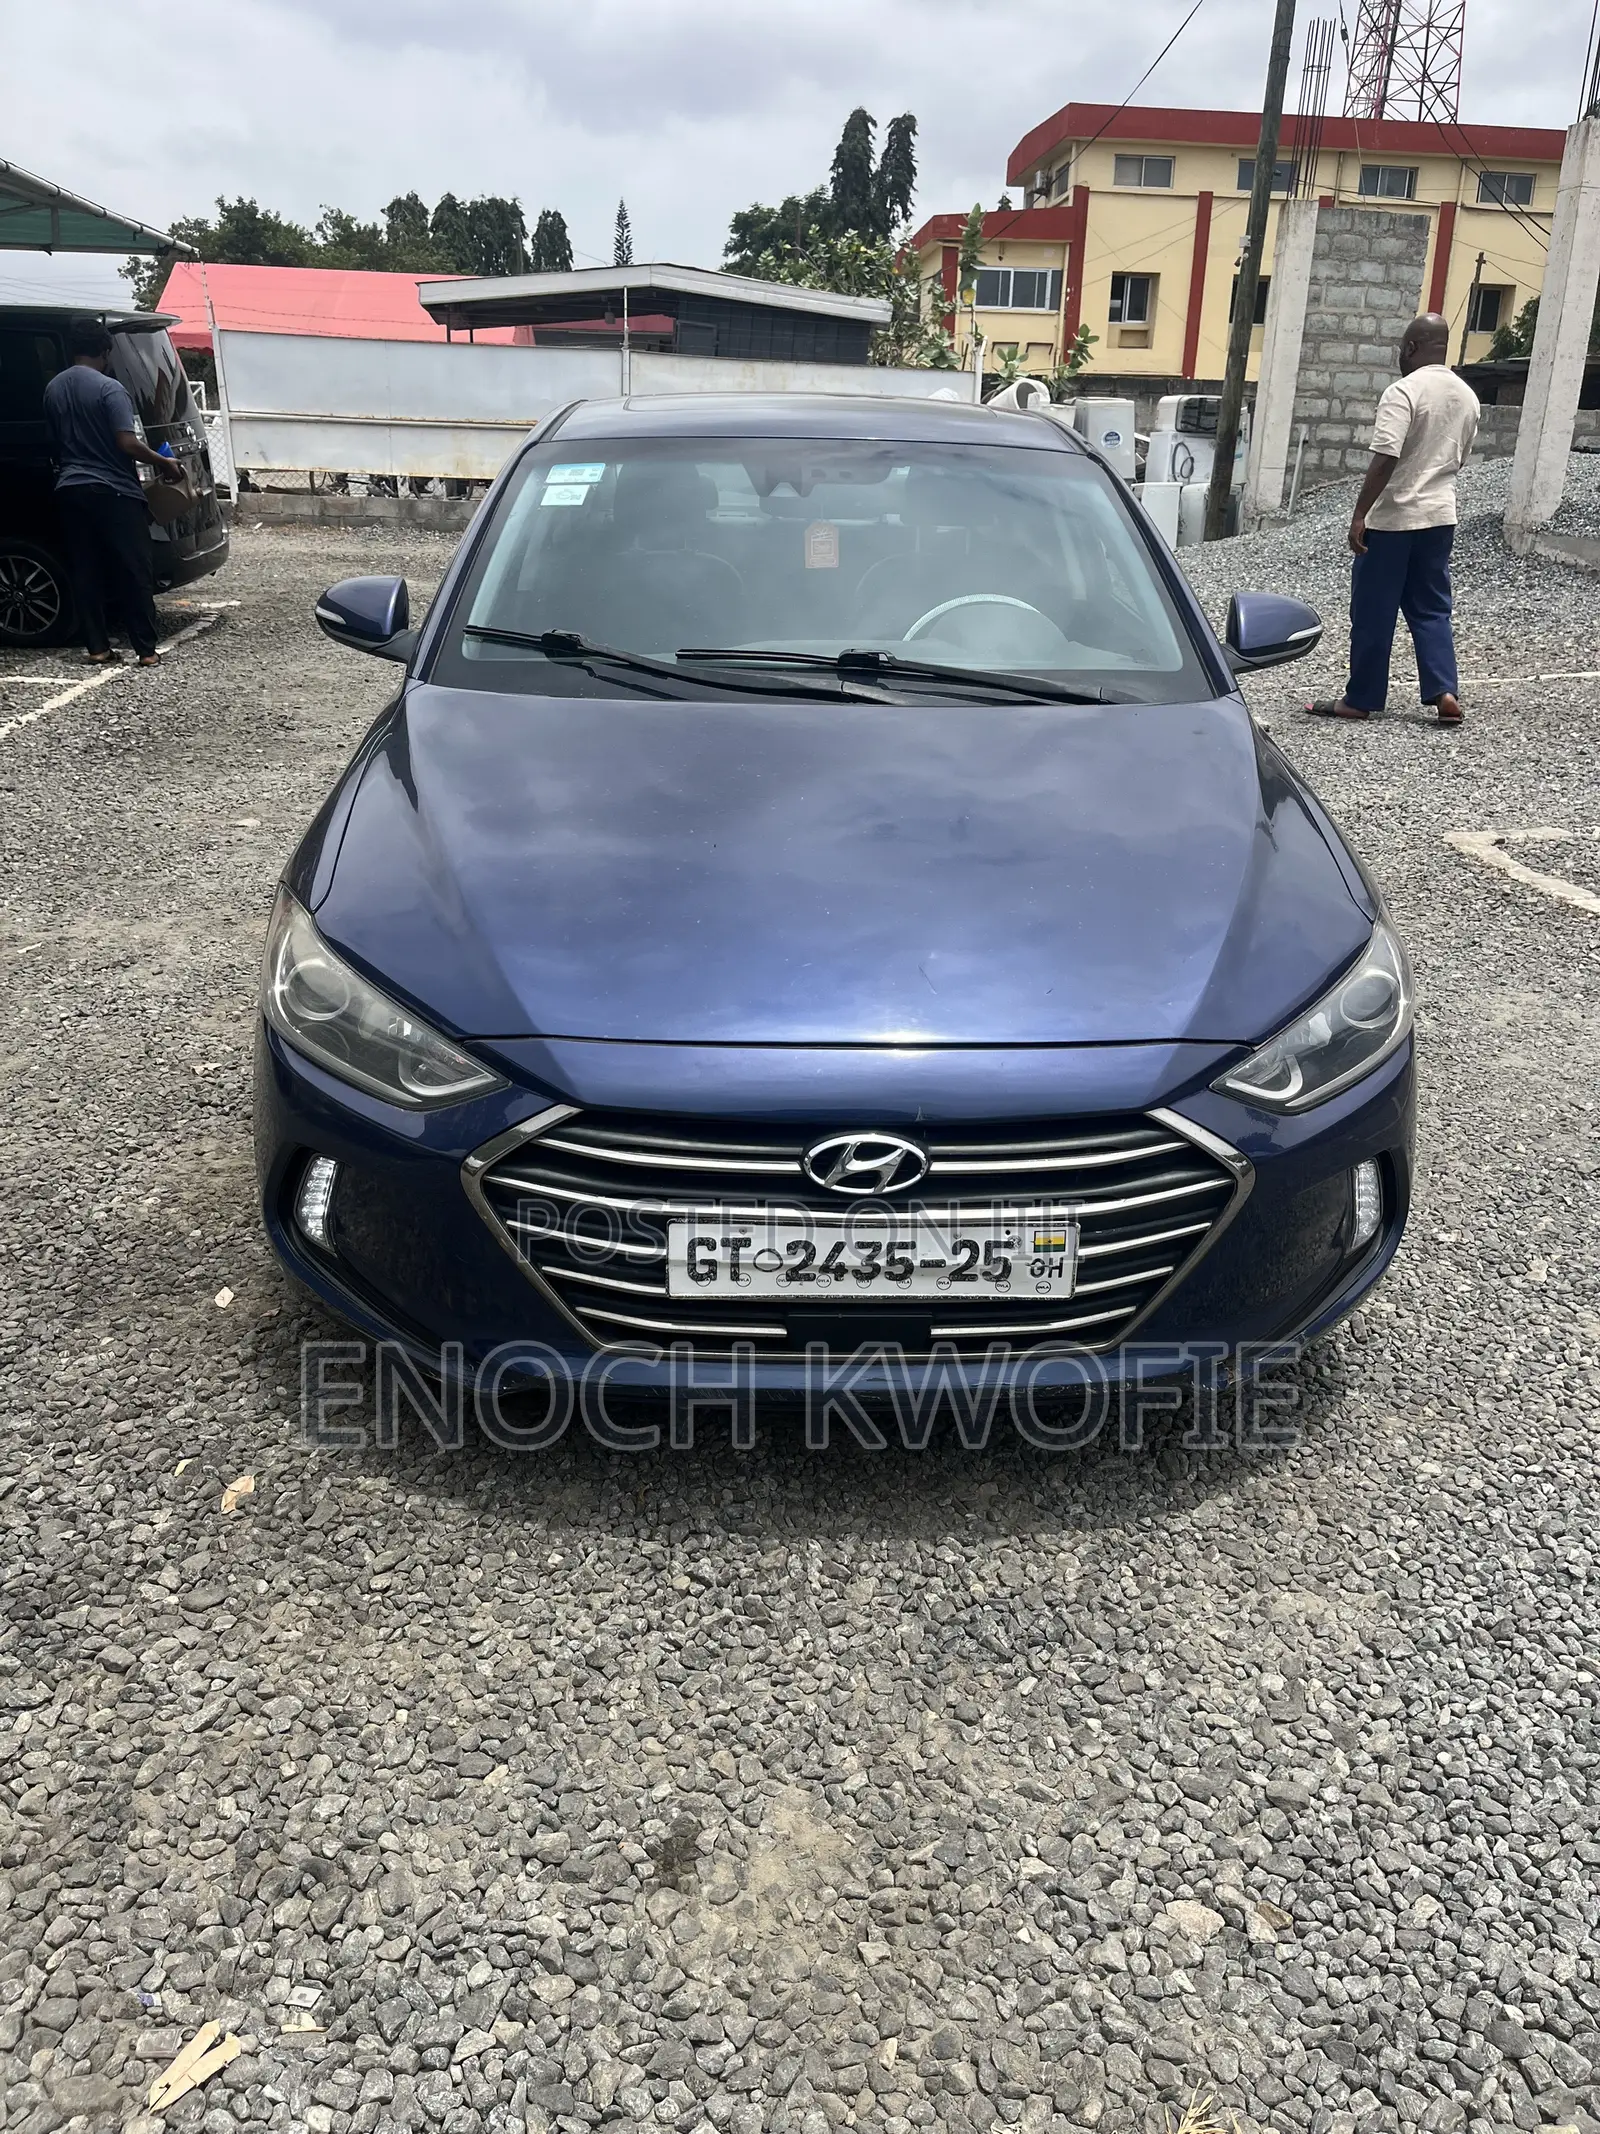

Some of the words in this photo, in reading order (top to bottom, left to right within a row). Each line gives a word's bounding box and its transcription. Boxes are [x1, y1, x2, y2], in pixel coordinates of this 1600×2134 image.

[687, 1237, 751, 1282] GT
[786, 1239, 1013, 1282] 2435-25
[1029, 1257, 1063, 1278] GH
